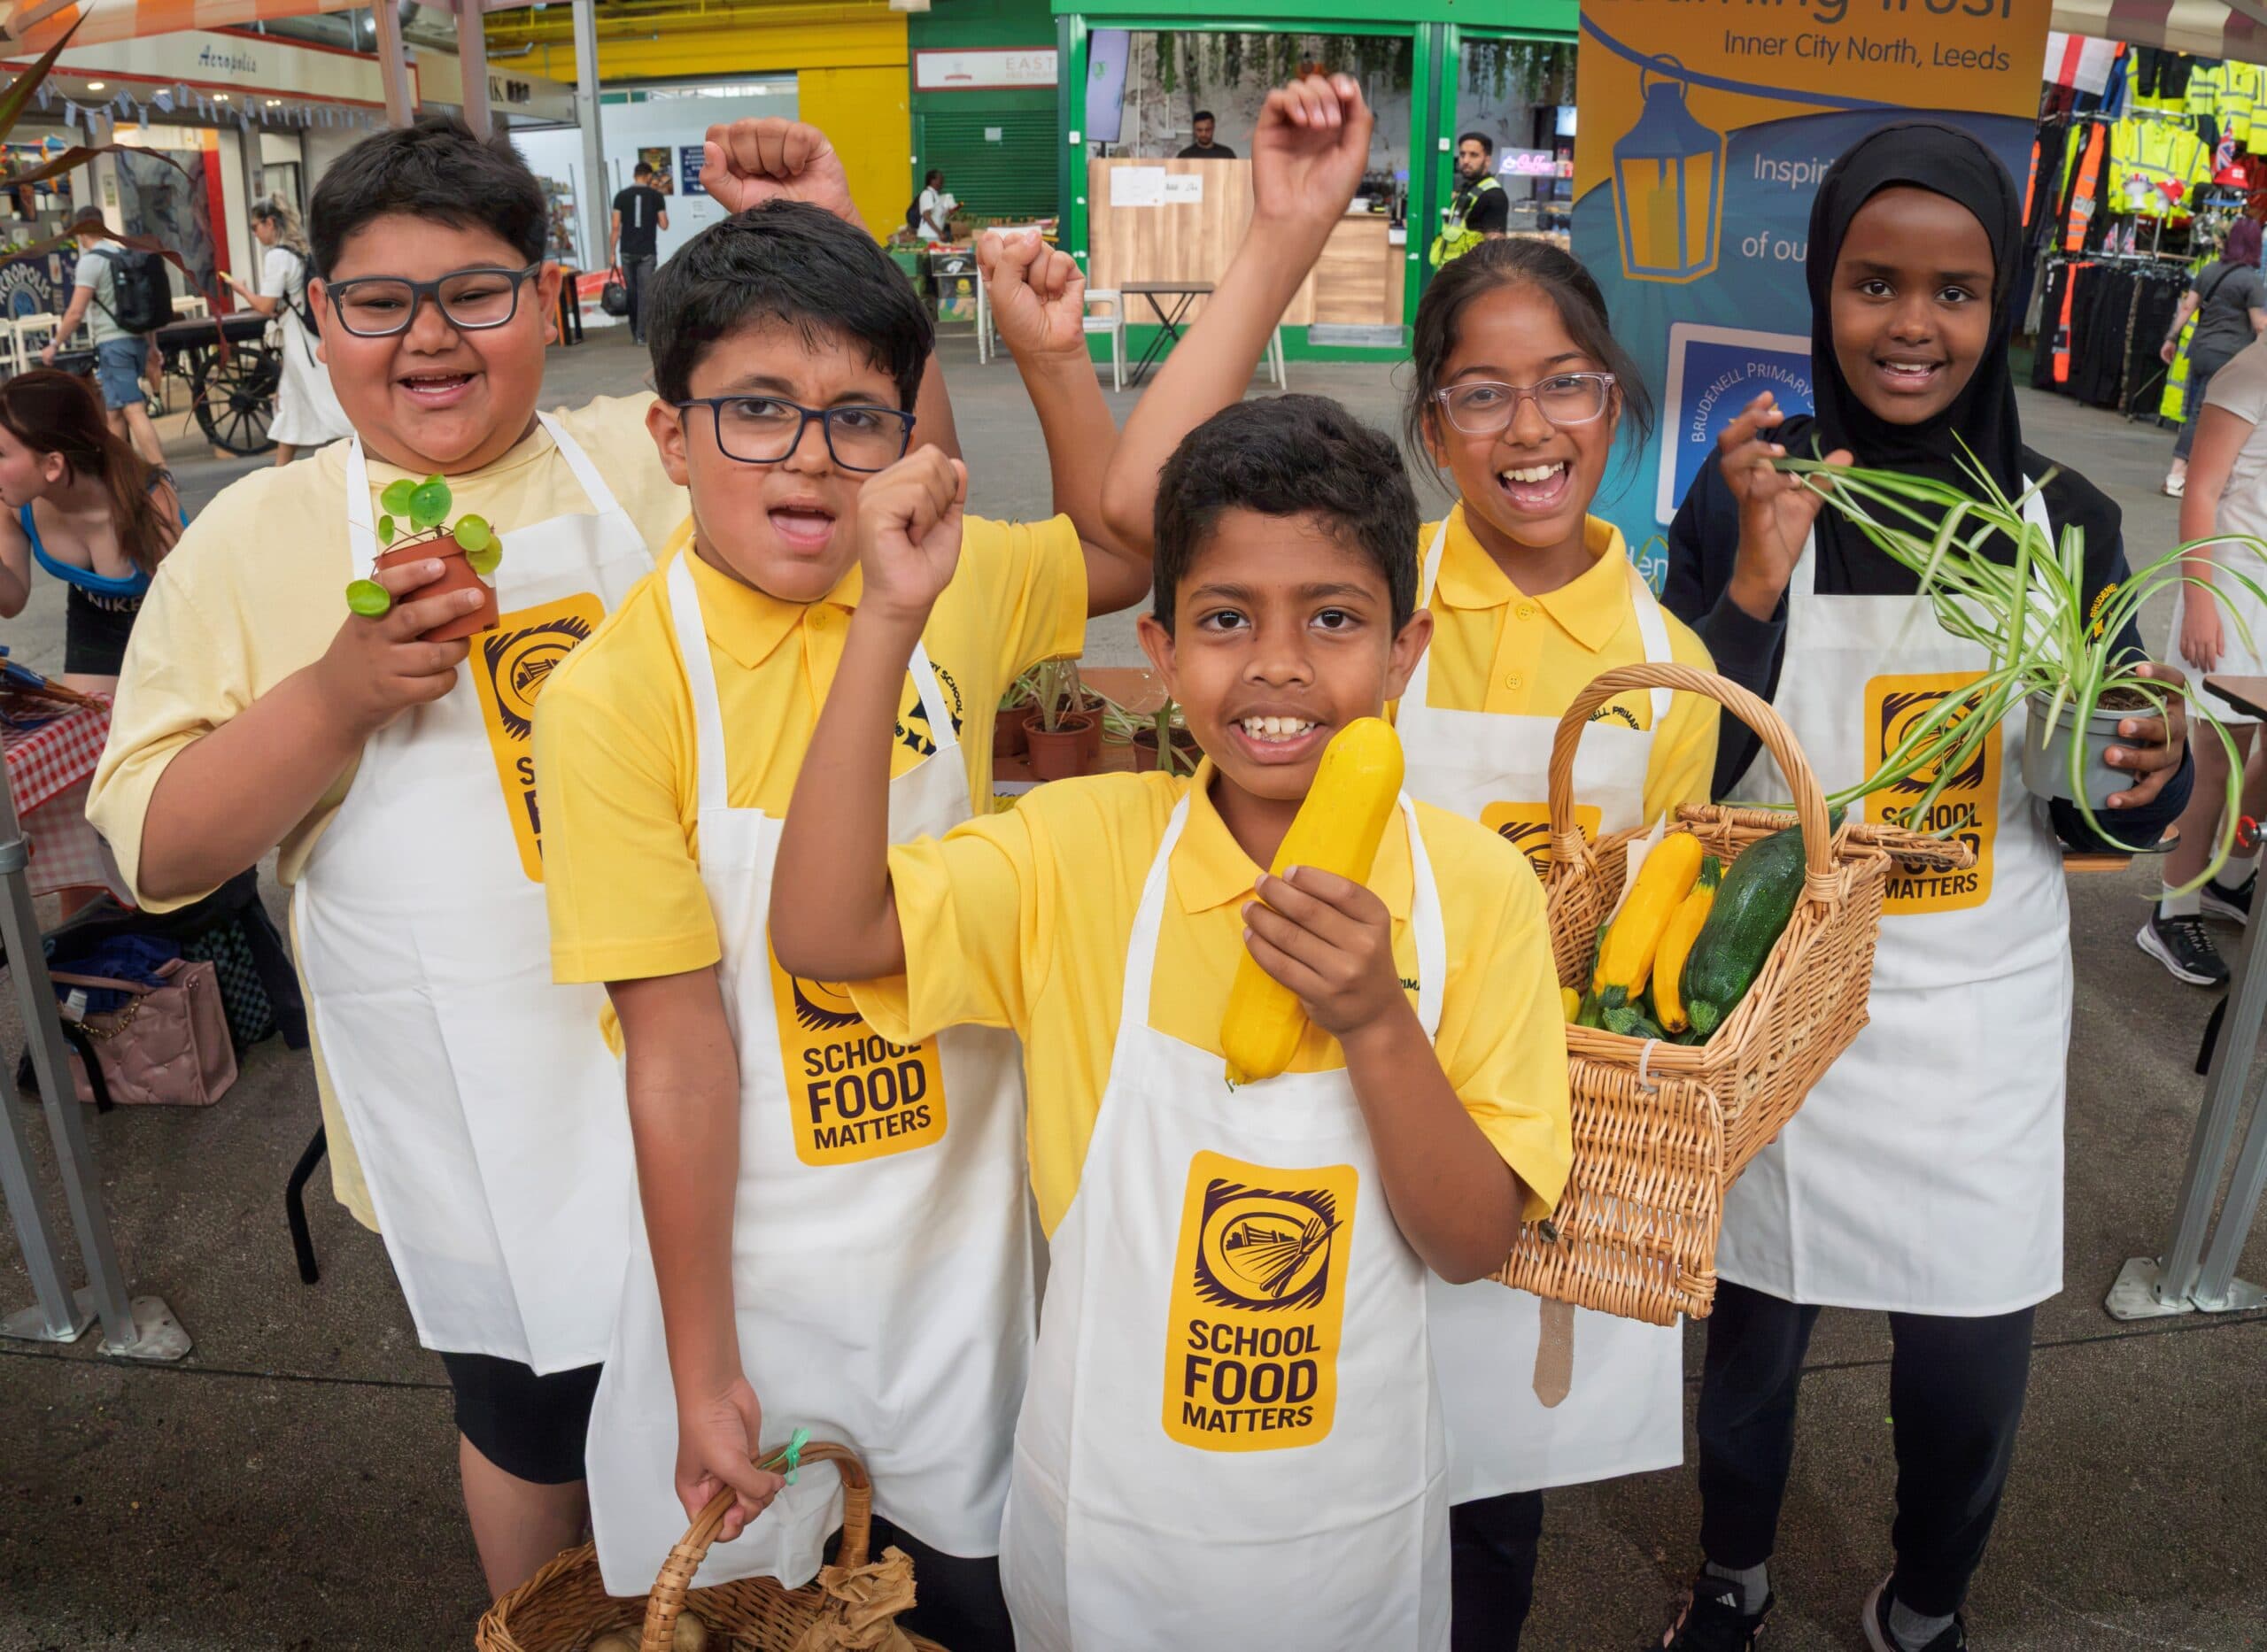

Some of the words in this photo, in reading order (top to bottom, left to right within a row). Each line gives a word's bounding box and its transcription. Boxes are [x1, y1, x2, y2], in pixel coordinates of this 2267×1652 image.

[1724, 30, 1788, 57] Inner
[1795, 33, 1840, 66] City
[1847, 35, 1923, 68] North,
[1933, 42, 2010, 71] Leeds
[1754, 153, 1835, 190] Inspir
[1742, 230, 1769, 259] of
[1691, 368, 1744, 443] BRUDENELL
[1746, 362, 1813, 398] PRIMARY
[940, 669, 963, 714] SCHOOL
[1884, 873, 1978, 899] MATTERS
[808, 1059, 926, 1124] FOOD
[813, 1105, 932, 1150] MATTERS
[1187, 1319, 1320, 1357] SCHOOL
[1184, 1354, 1318, 1405] FOOD
[1182, 1401, 1314, 1433] MATTERS
